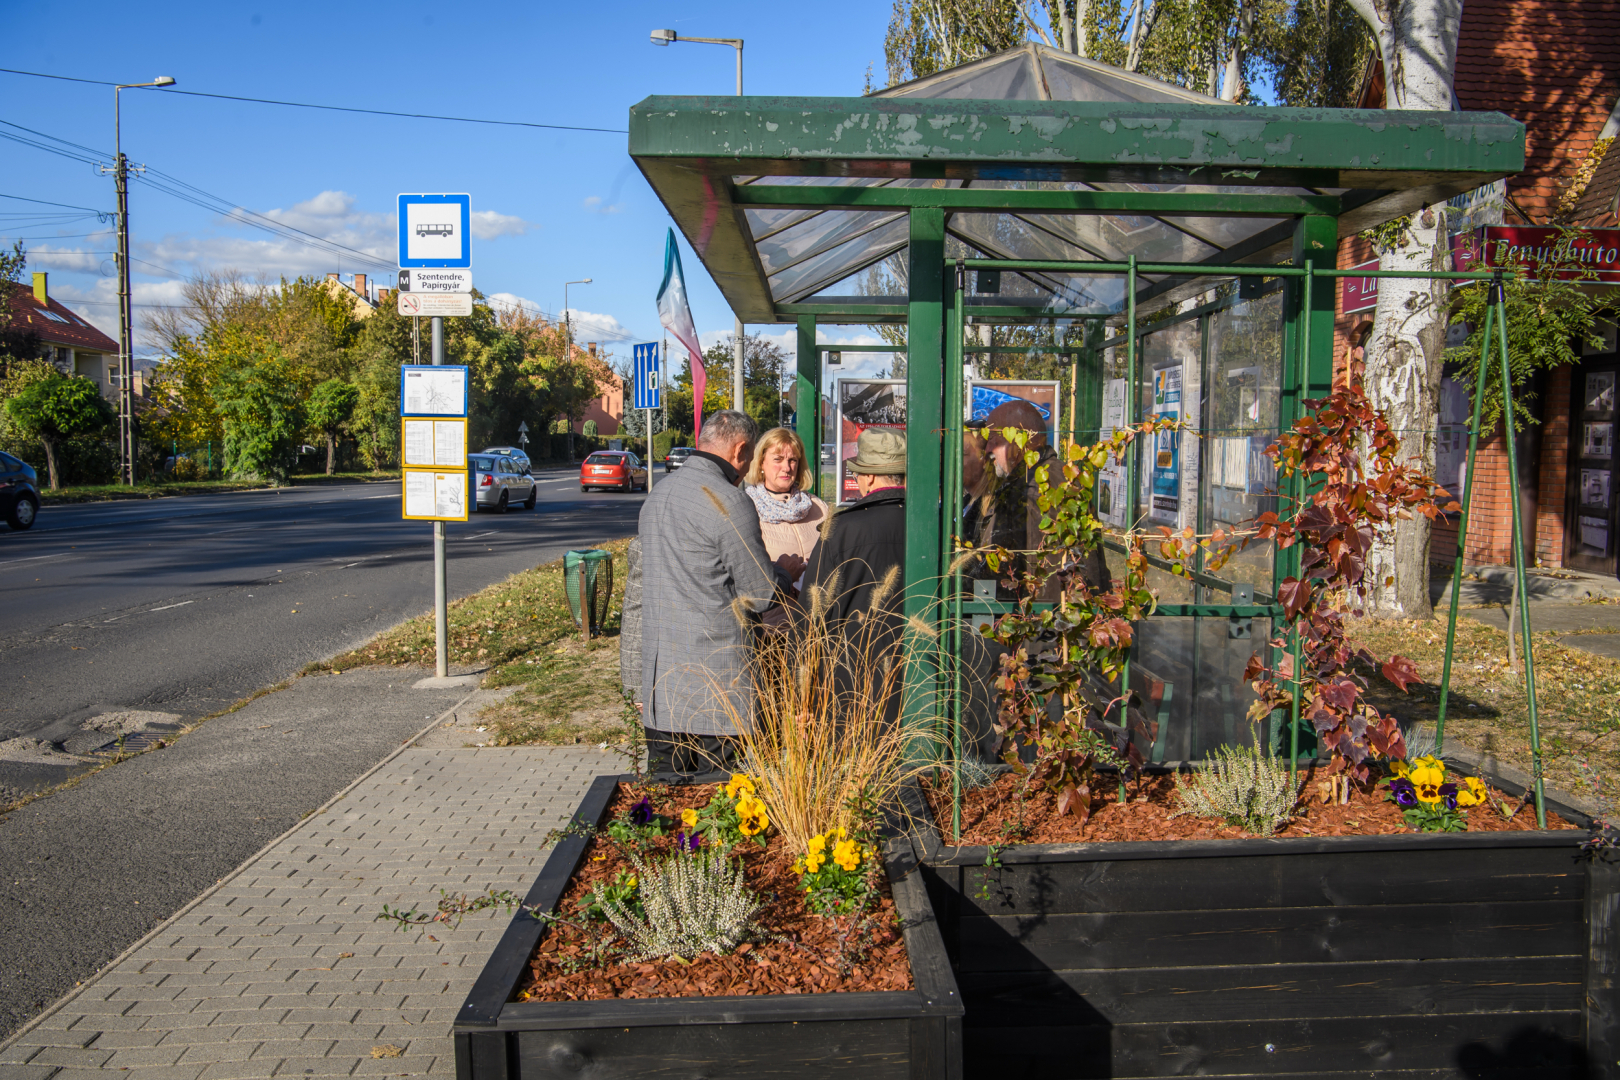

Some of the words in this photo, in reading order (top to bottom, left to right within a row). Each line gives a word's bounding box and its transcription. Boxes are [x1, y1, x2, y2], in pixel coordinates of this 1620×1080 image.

[1492, 236, 1620, 273] Fenyőbúto
[400, 277, 409, 285] M
[417, 273, 465, 281] Szentendre,
[422, 281, 460, 290] Papírgyár
